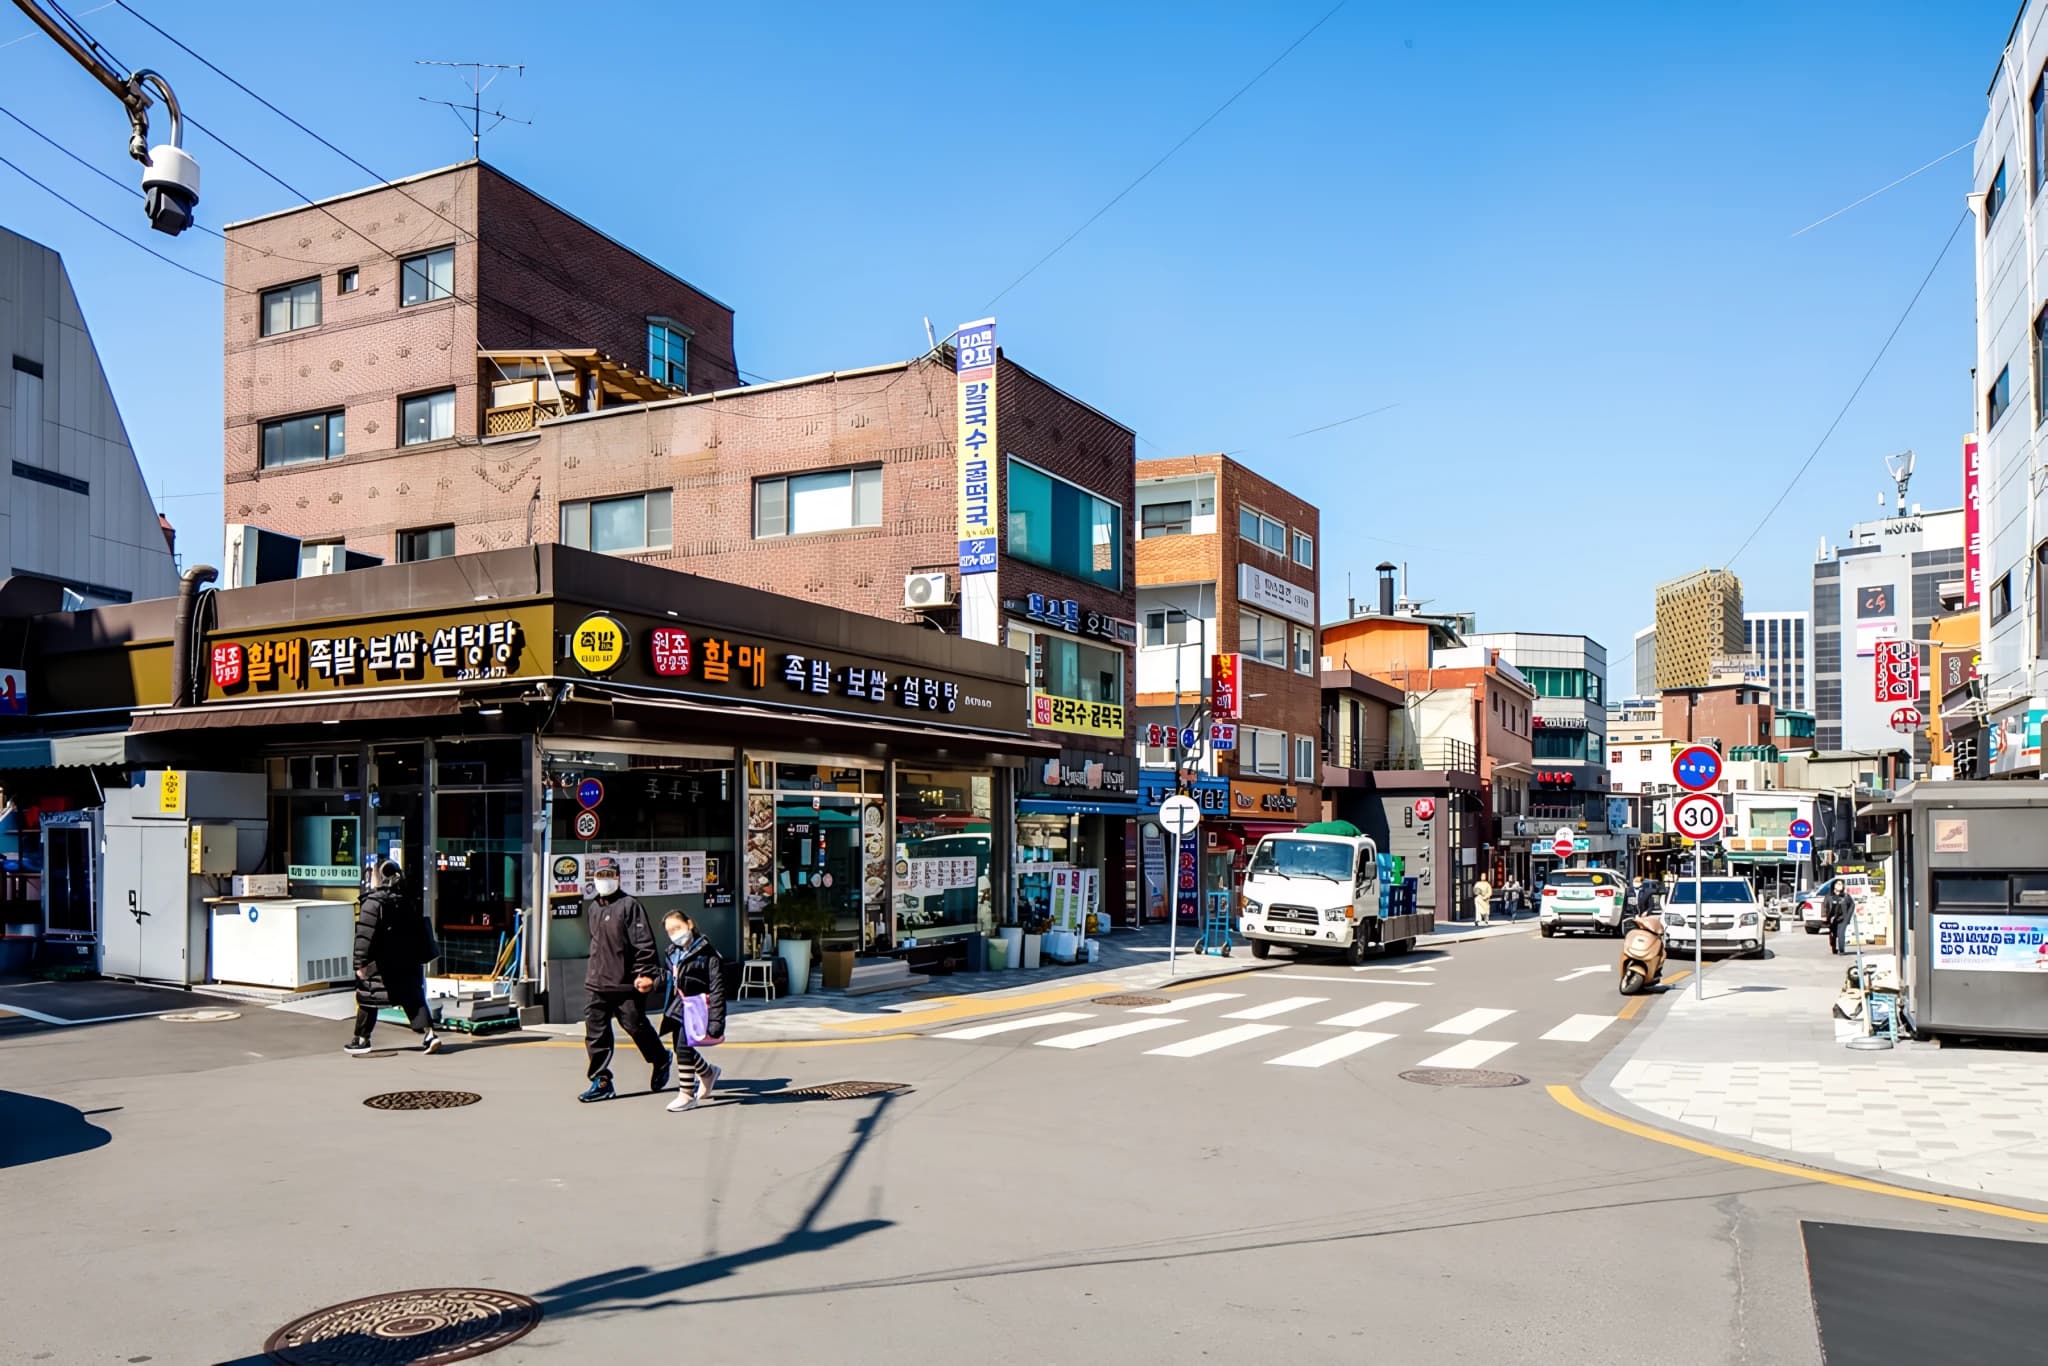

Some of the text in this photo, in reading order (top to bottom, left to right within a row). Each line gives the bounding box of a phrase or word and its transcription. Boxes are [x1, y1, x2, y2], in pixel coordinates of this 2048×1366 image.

[247, 638, 301, 683] 할매
[653, 631, 689, 656] 원조
[703, 637, 766, 688] 할매
[1684, 807, 1714, 827] 30
